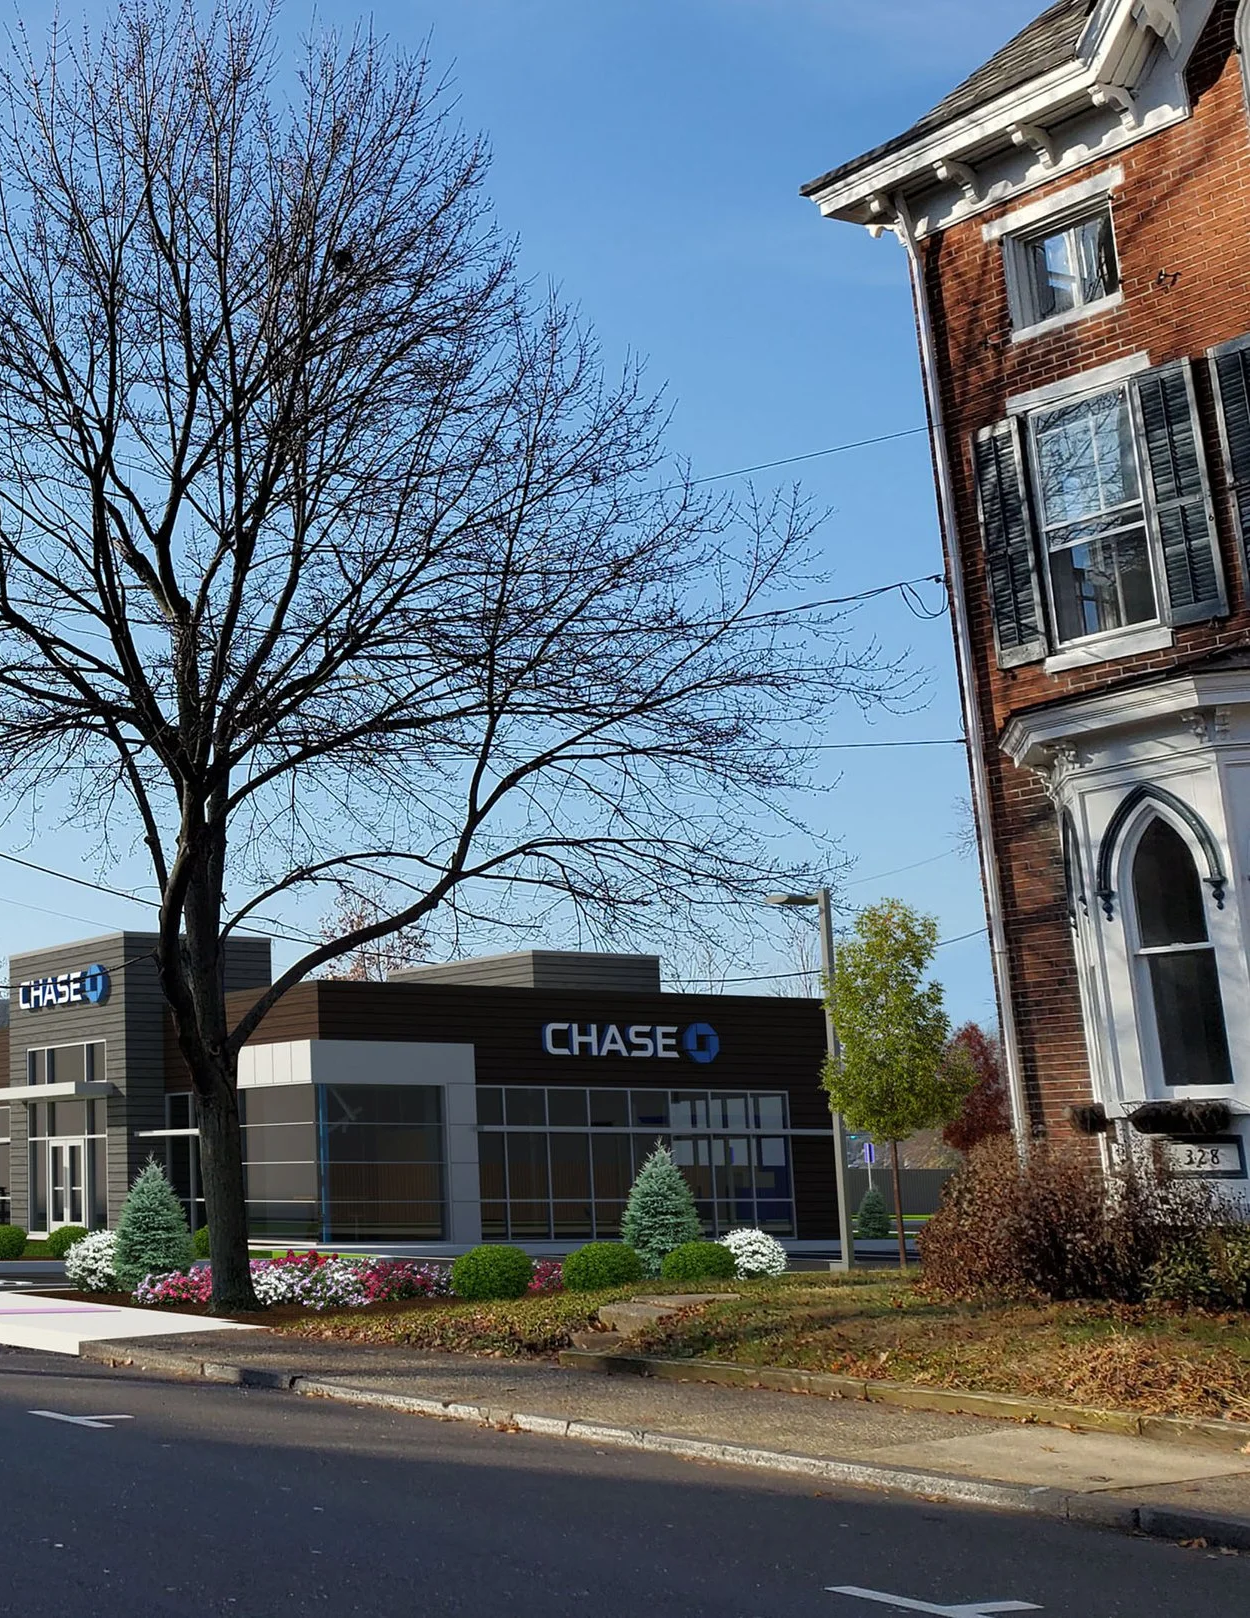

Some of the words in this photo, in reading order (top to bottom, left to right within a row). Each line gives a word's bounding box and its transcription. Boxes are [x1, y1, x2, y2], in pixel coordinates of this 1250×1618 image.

[19, 971, 82, 1009] CHASE
[542, 1022, 680, 1058] CHASE
[1184, 1149, 1220, 1167] 328
